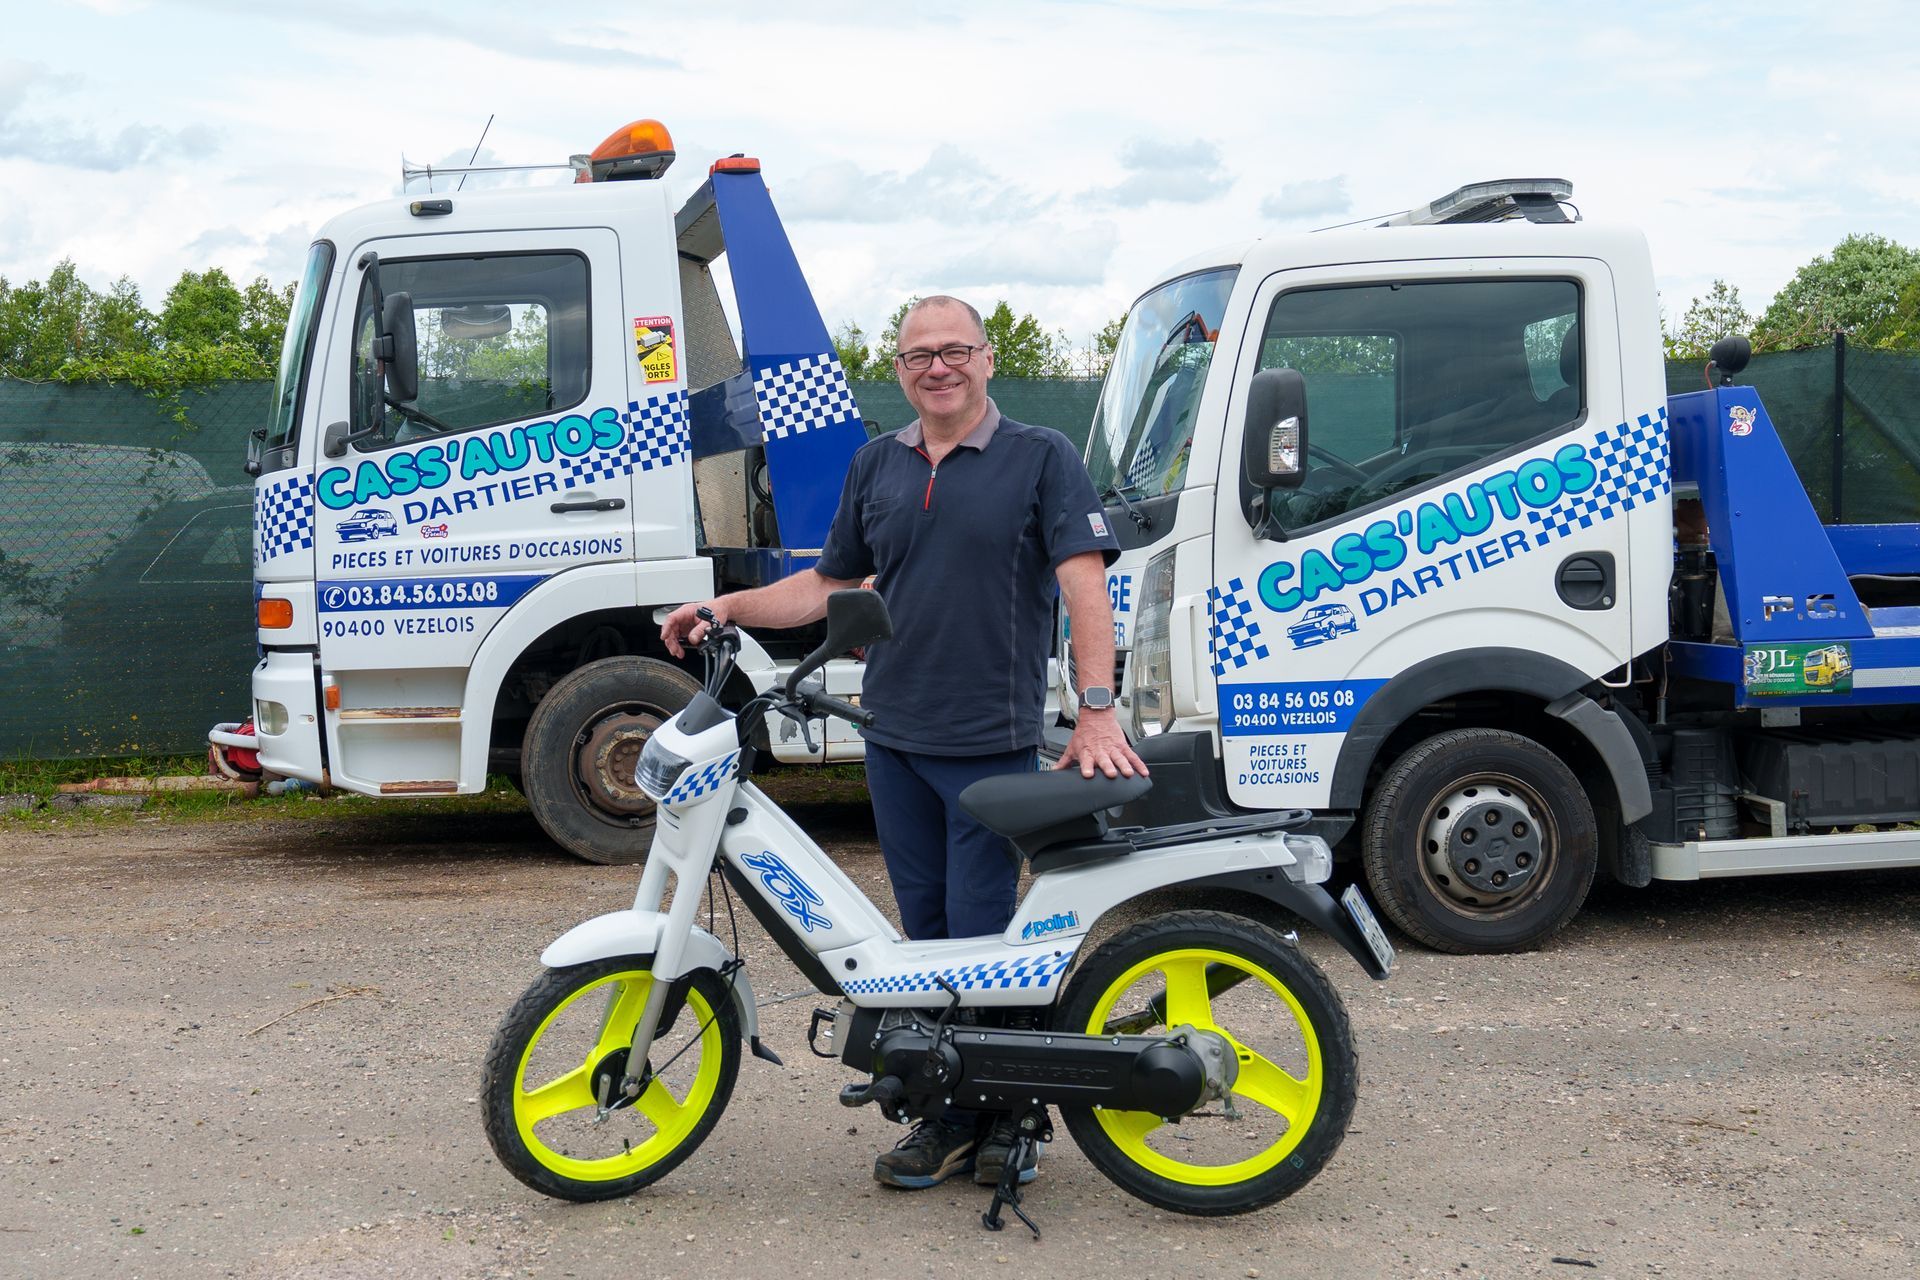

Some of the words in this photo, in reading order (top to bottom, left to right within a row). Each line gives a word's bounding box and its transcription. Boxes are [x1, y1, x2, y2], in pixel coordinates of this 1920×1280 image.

[633, 318, 671, 327] TTENTION
[643, 363, 671, 372] NGLES
[645, 371, 670, 379] ORTS
[317, 407, 625, 511] CASS'AUTOS
[403, 472, 560, 525] DARTIER
[1257, 444, 1597, 612] CASS'AUTOS
[332, 551, 387, 569] PIECES
[395, 550, 413, 565] ET
[420, 545, 501, 564] VOITURES
[509, 537, 622, 559] D'OCCASIONS
[1358, 530, 1531, 617] DARTIER
[348, 582, 498, 606] 03.84.56.05.08
[323, 620, 385, 638] 90400
[394, 616, 475, 635] VEZELOIS
[1752, 649, 1795, 671] PJL
[1233, 693, 1254, 710] 03
[1259, 693, 1280, 709] 84
[1284, 692, 1304, 708] 56
[1309, 691, 1329, 707] 05
[1333, 689, 1354, 706] 08
[1234, 713, 1278, 727] 90400
[1281, 711, 1337, 725] VEZELOIS
[1249, 744, 1288, 757] PIECES
[1293, 744, 1307, 755] ET
[1250, 758, 1307, 771] VOITURES
[1238, 772, 1319, 785] D'OCCASIONS
[1032, 910, 1076, 937] polini
